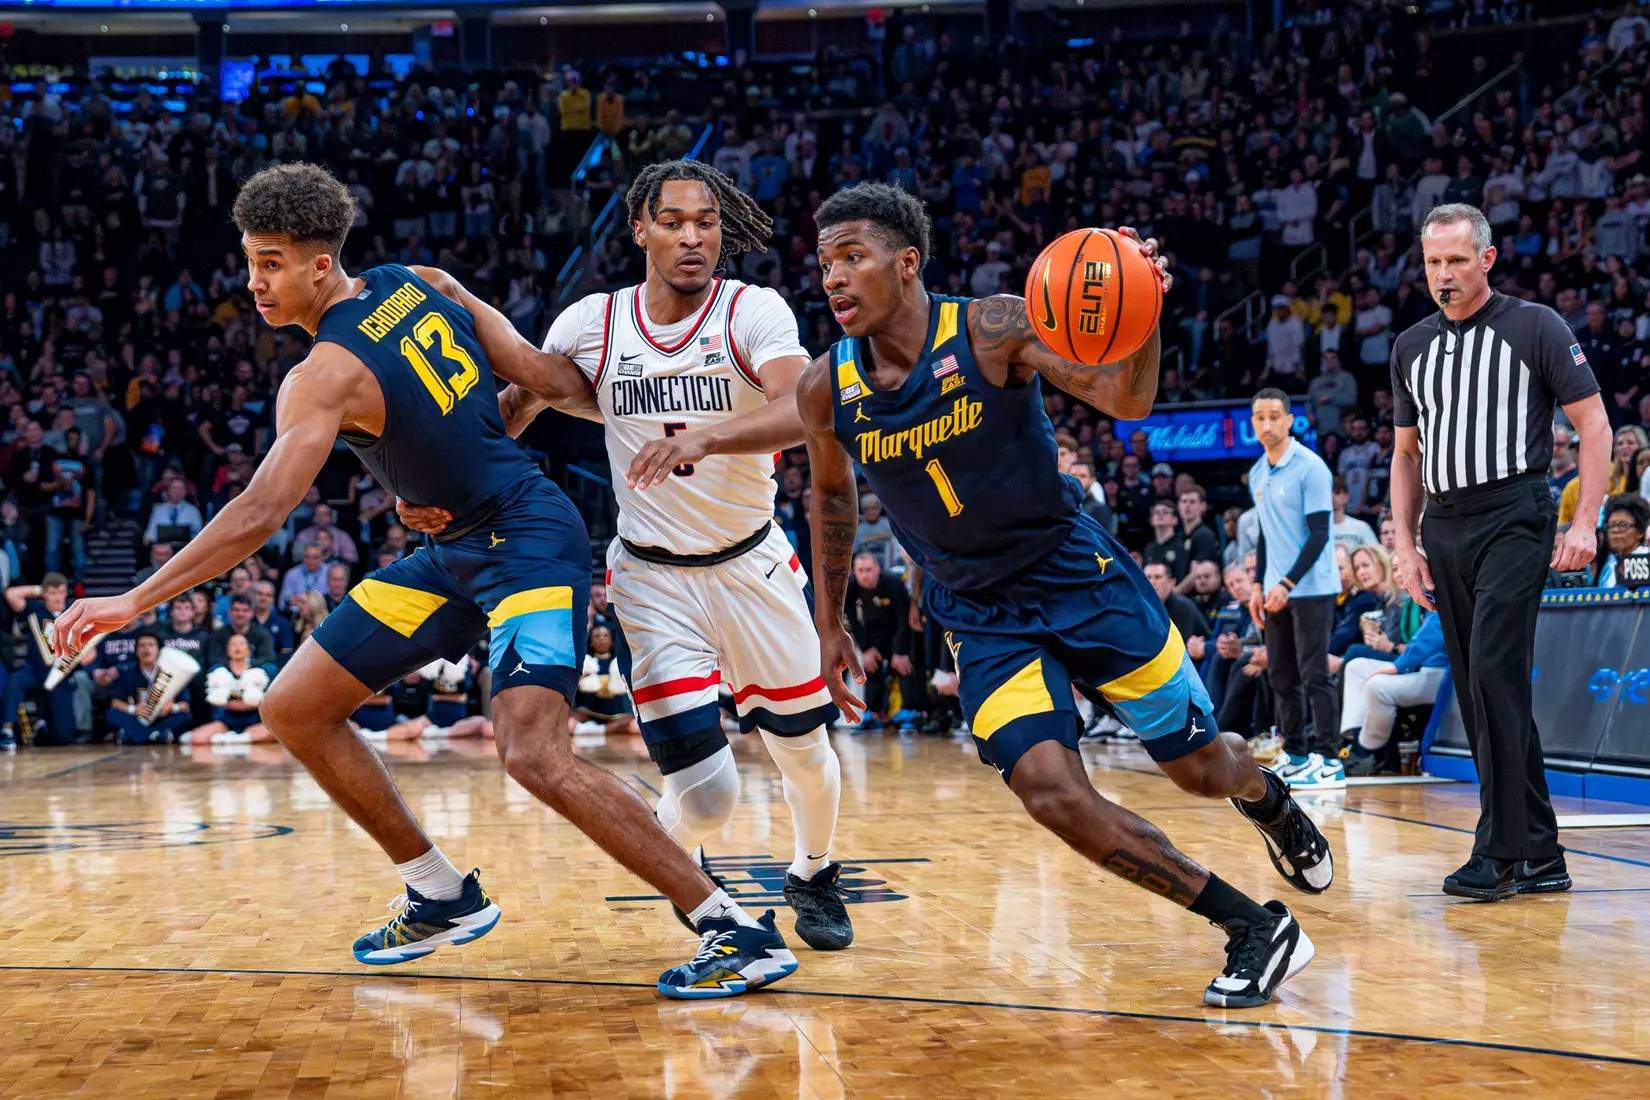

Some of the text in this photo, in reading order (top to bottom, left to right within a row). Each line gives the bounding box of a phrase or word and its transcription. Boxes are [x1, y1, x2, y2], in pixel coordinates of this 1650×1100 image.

[357, 282, 427, 343] IGHODARO
[1079, 261, 1104, 334] ELITE
[400, 311, 480, 416] 13
[612, 376, 733, 416] CONNECTICUT
[855, 395, 984, 464] Marquette
[925, 458, 965, 518] 1
[1624, 558, 1650, 580] POSS
